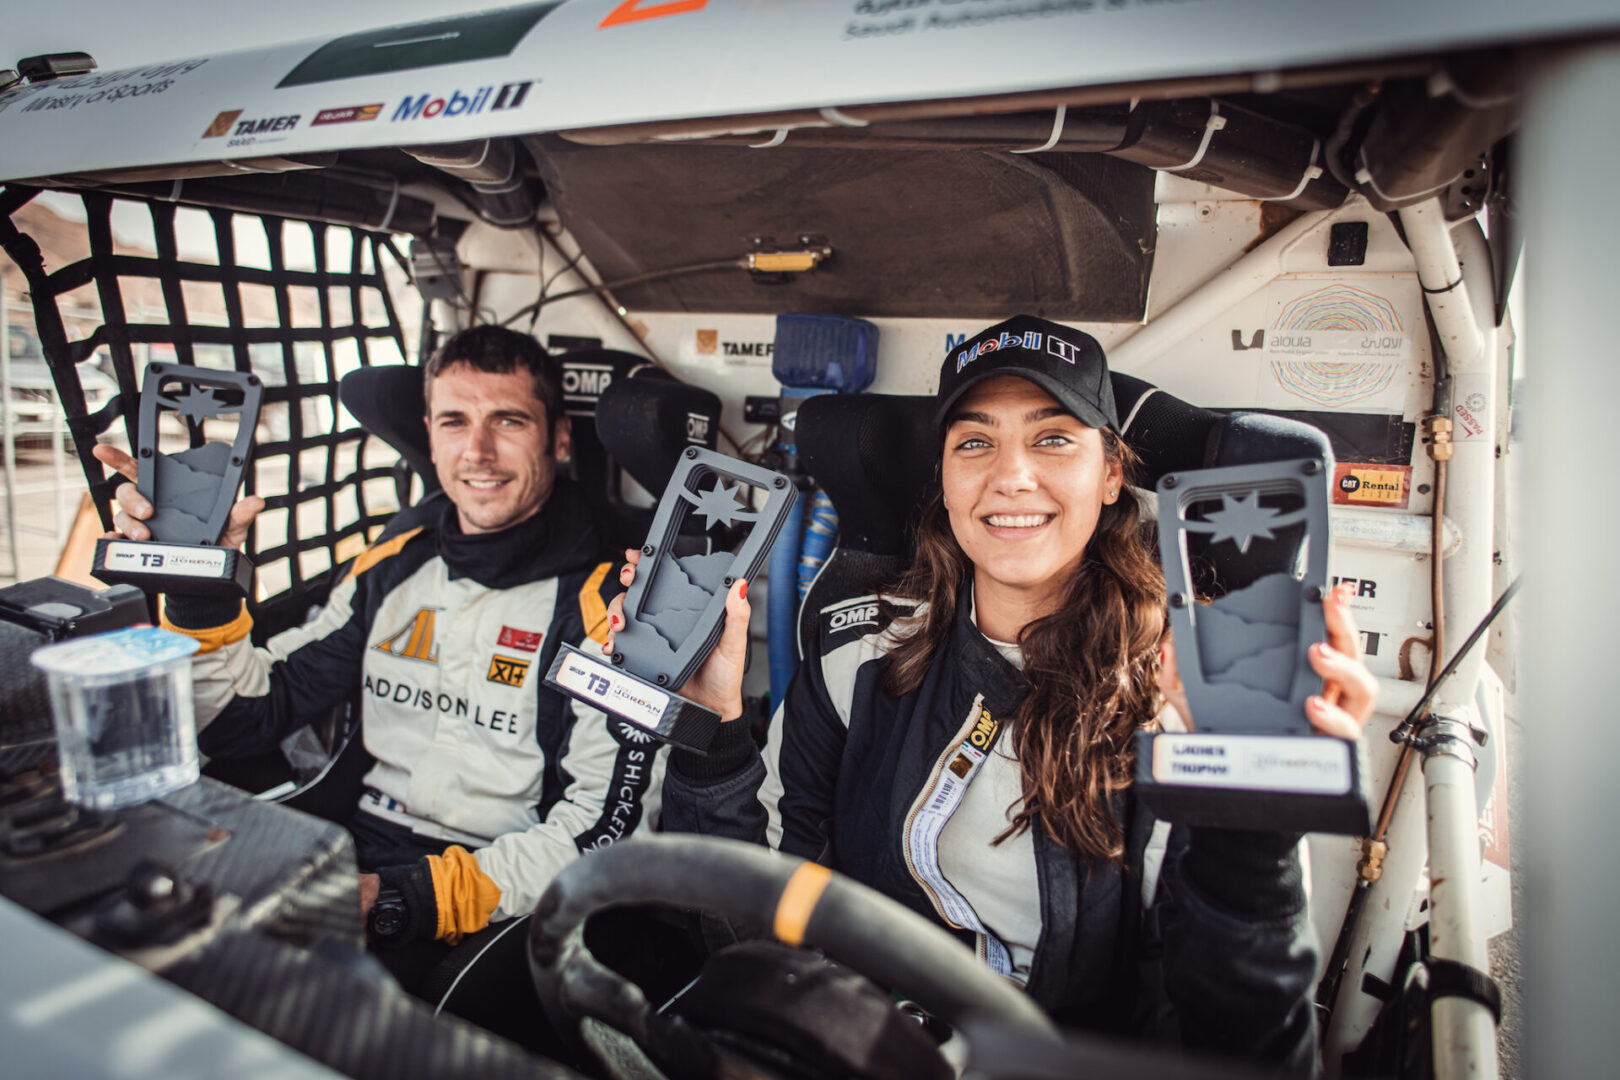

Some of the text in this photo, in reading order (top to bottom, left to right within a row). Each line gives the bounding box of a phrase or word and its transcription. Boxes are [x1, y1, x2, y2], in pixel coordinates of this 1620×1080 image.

[390, 84, 494, 113] Mobil
[224, 114, 302, 137] TAMER
[956, 330, 1043, 374] Mobil
[563, 370, 612, 394] OMP
[1361, 480, 1400, 491] Rental
[140, 553, 165, 568] T3
[829, 605, 880, 629] OMP
[586, 672, 611, 697] T3
[364, 674, 518, 734] ADDISON LEE
[613, 687, 662, 714] JORDAN
[970, 709, 995, 746] OMP
